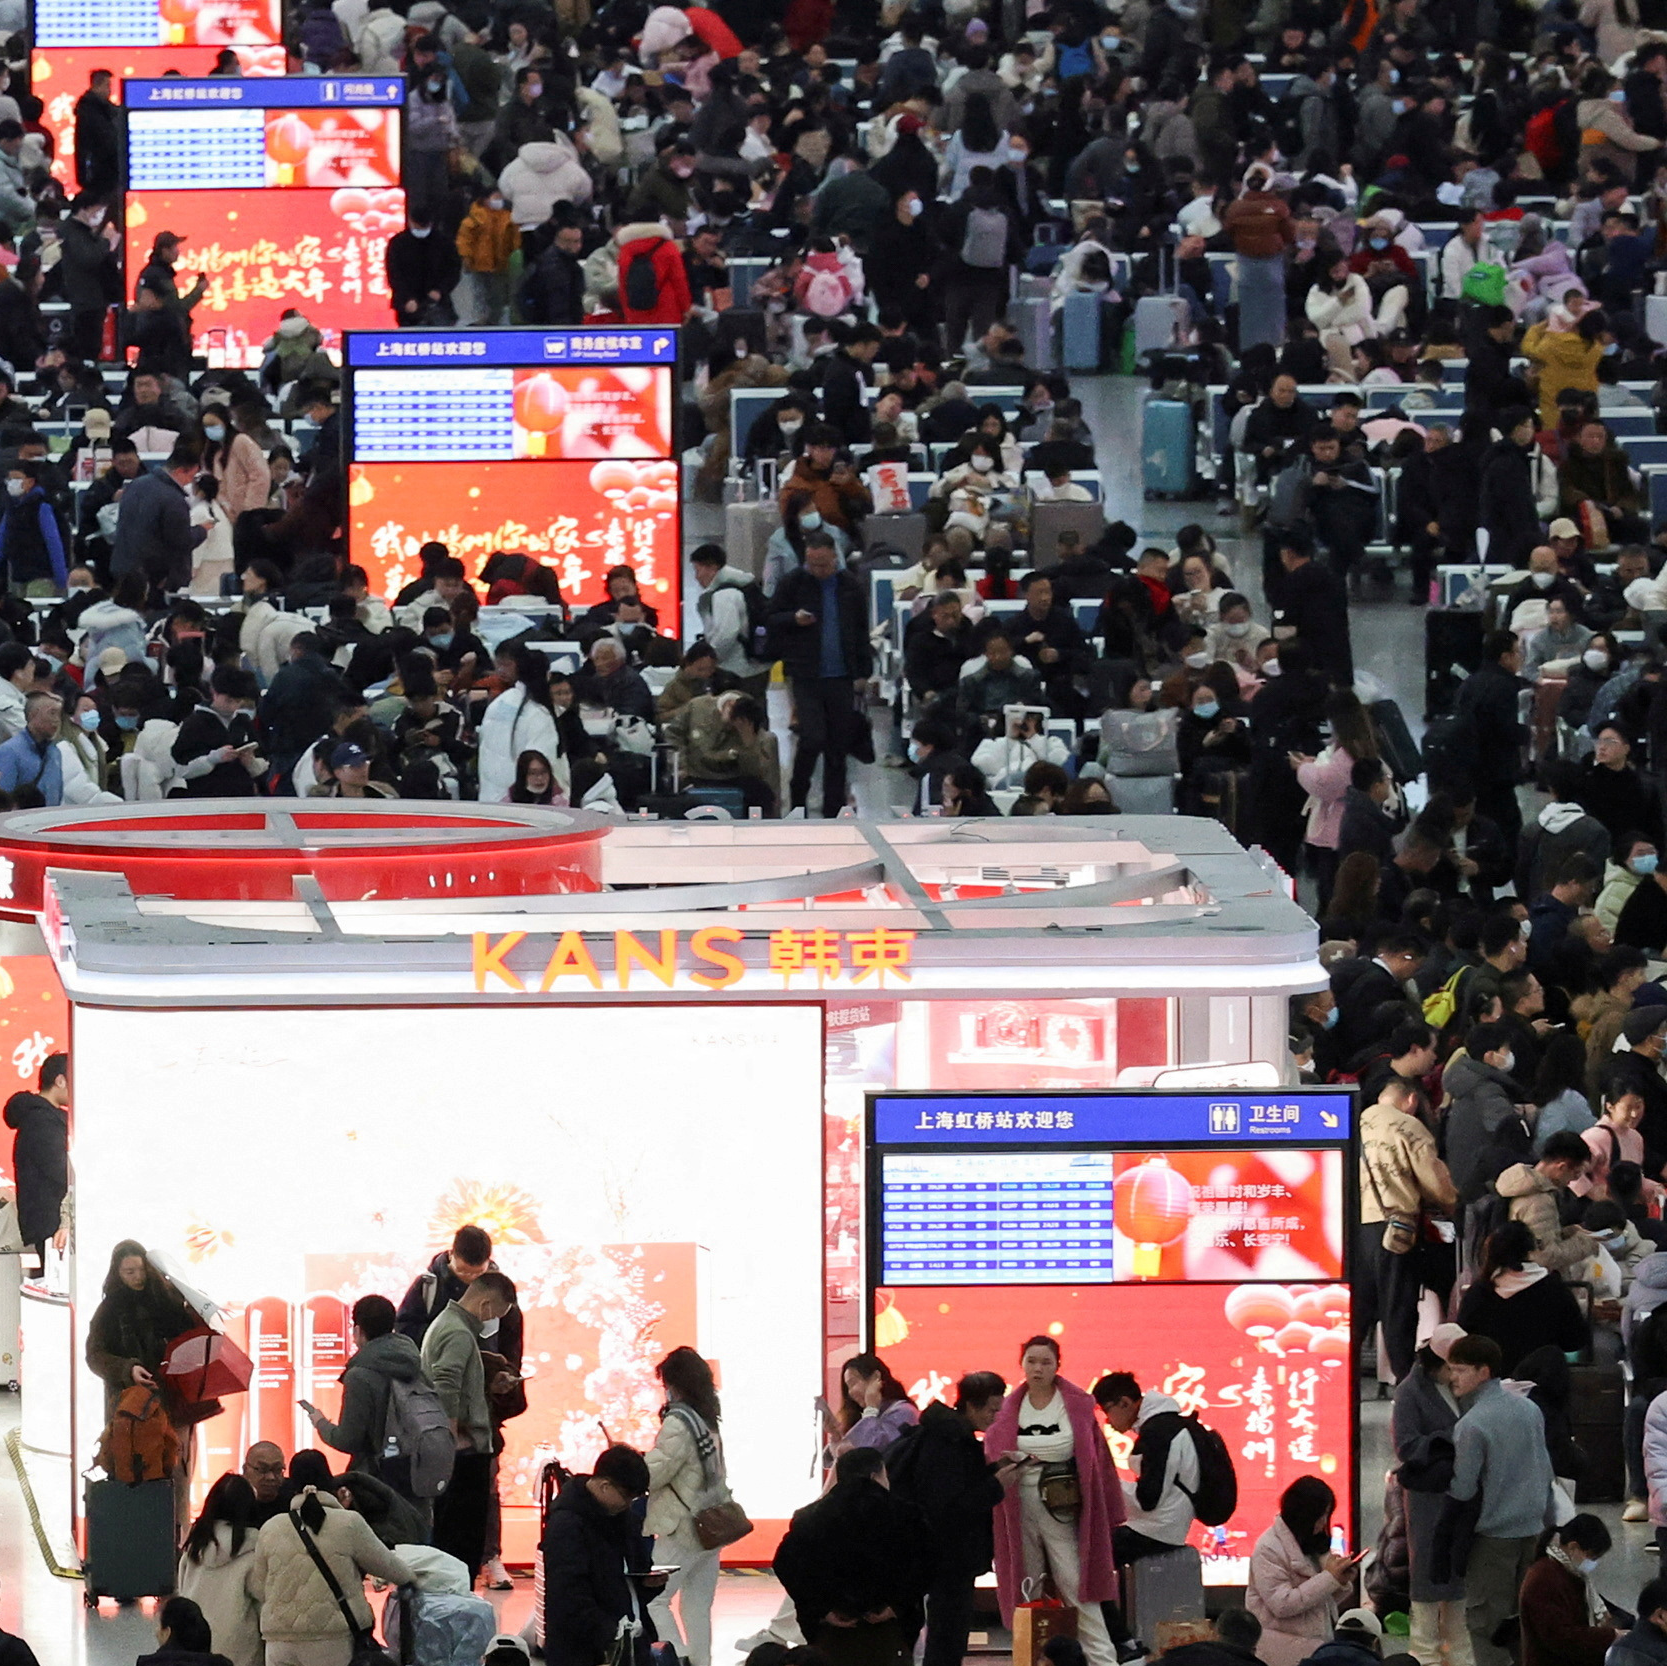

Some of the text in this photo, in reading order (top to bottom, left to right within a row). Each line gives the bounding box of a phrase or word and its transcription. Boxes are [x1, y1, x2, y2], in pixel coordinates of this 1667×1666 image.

[472, 926, 916, 992] KANS 韩束
[915, 1111, 1074, 1129] 上海虹桥站欢迎您
[1248, 1105, 1300, 1123] 卫生间
[1249, 1126, 1291, 1134] Restrooms
